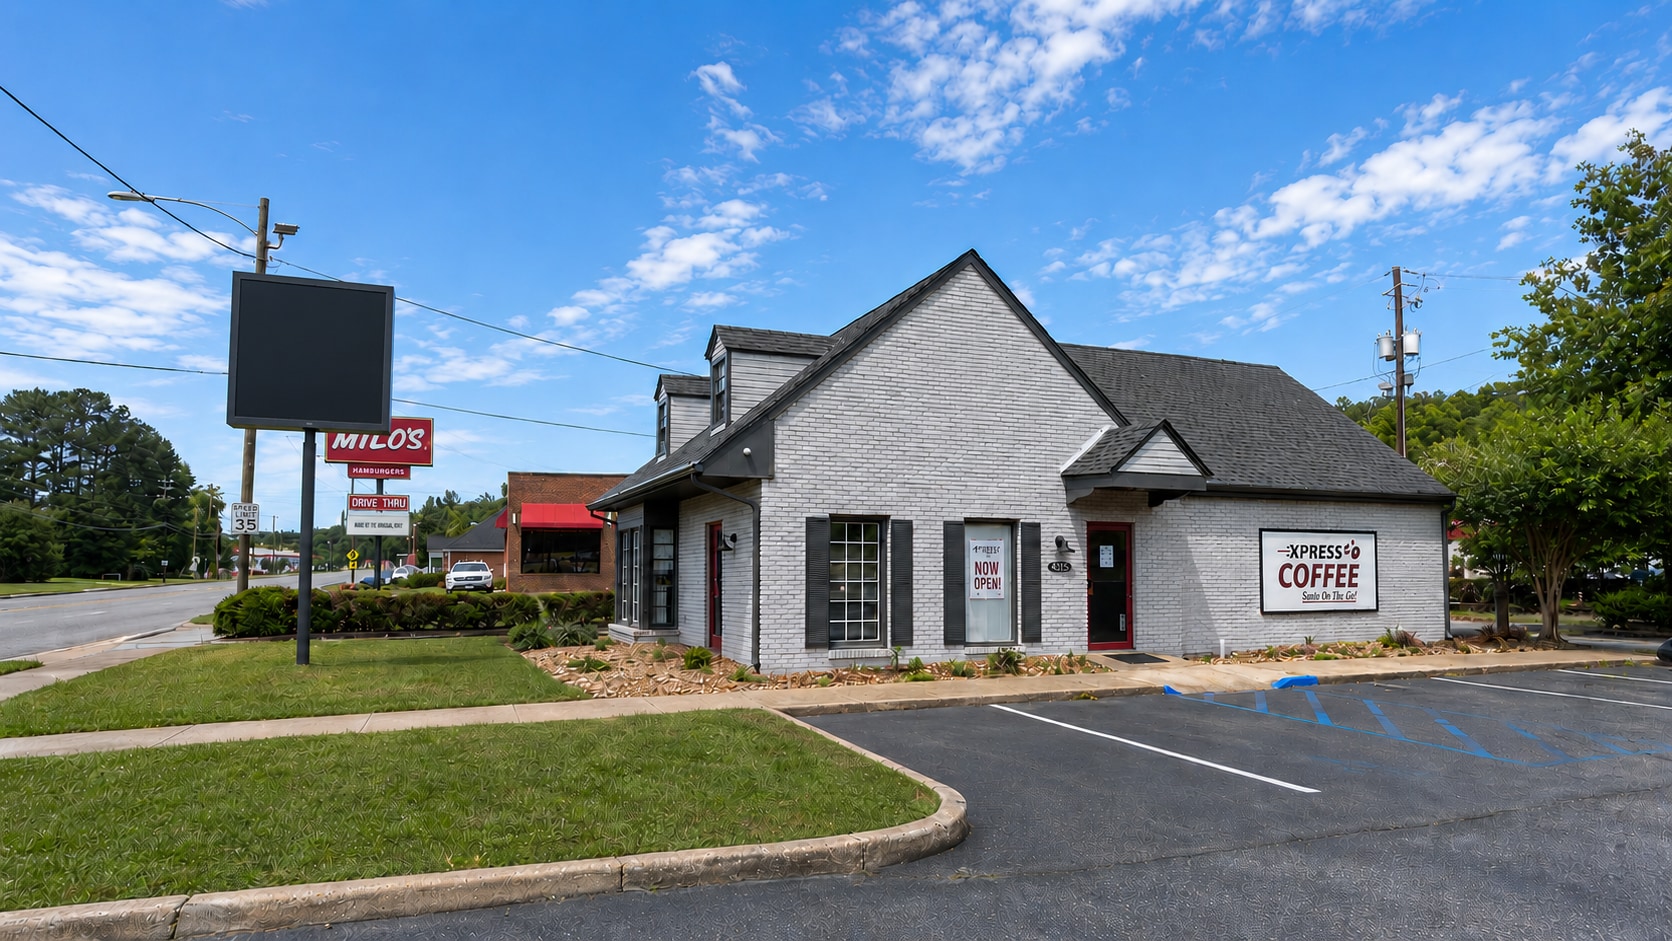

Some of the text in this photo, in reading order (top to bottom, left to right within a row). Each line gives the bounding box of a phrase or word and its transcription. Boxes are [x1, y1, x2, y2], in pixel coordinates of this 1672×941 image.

[331, 427, 425, 450] MILO'S
[352, 467, 405, 475] HAMBURGERS
[352, 498, 406, 508] DRIVE THRU
[235, 519, 256, 531] 35
[974, 561, 999, 576] NOW
[1278, 563, 1360, 588] COFFEE
[974, 577, 1002, 590] OPEN!
[1321, 591, 1331, 600] On
